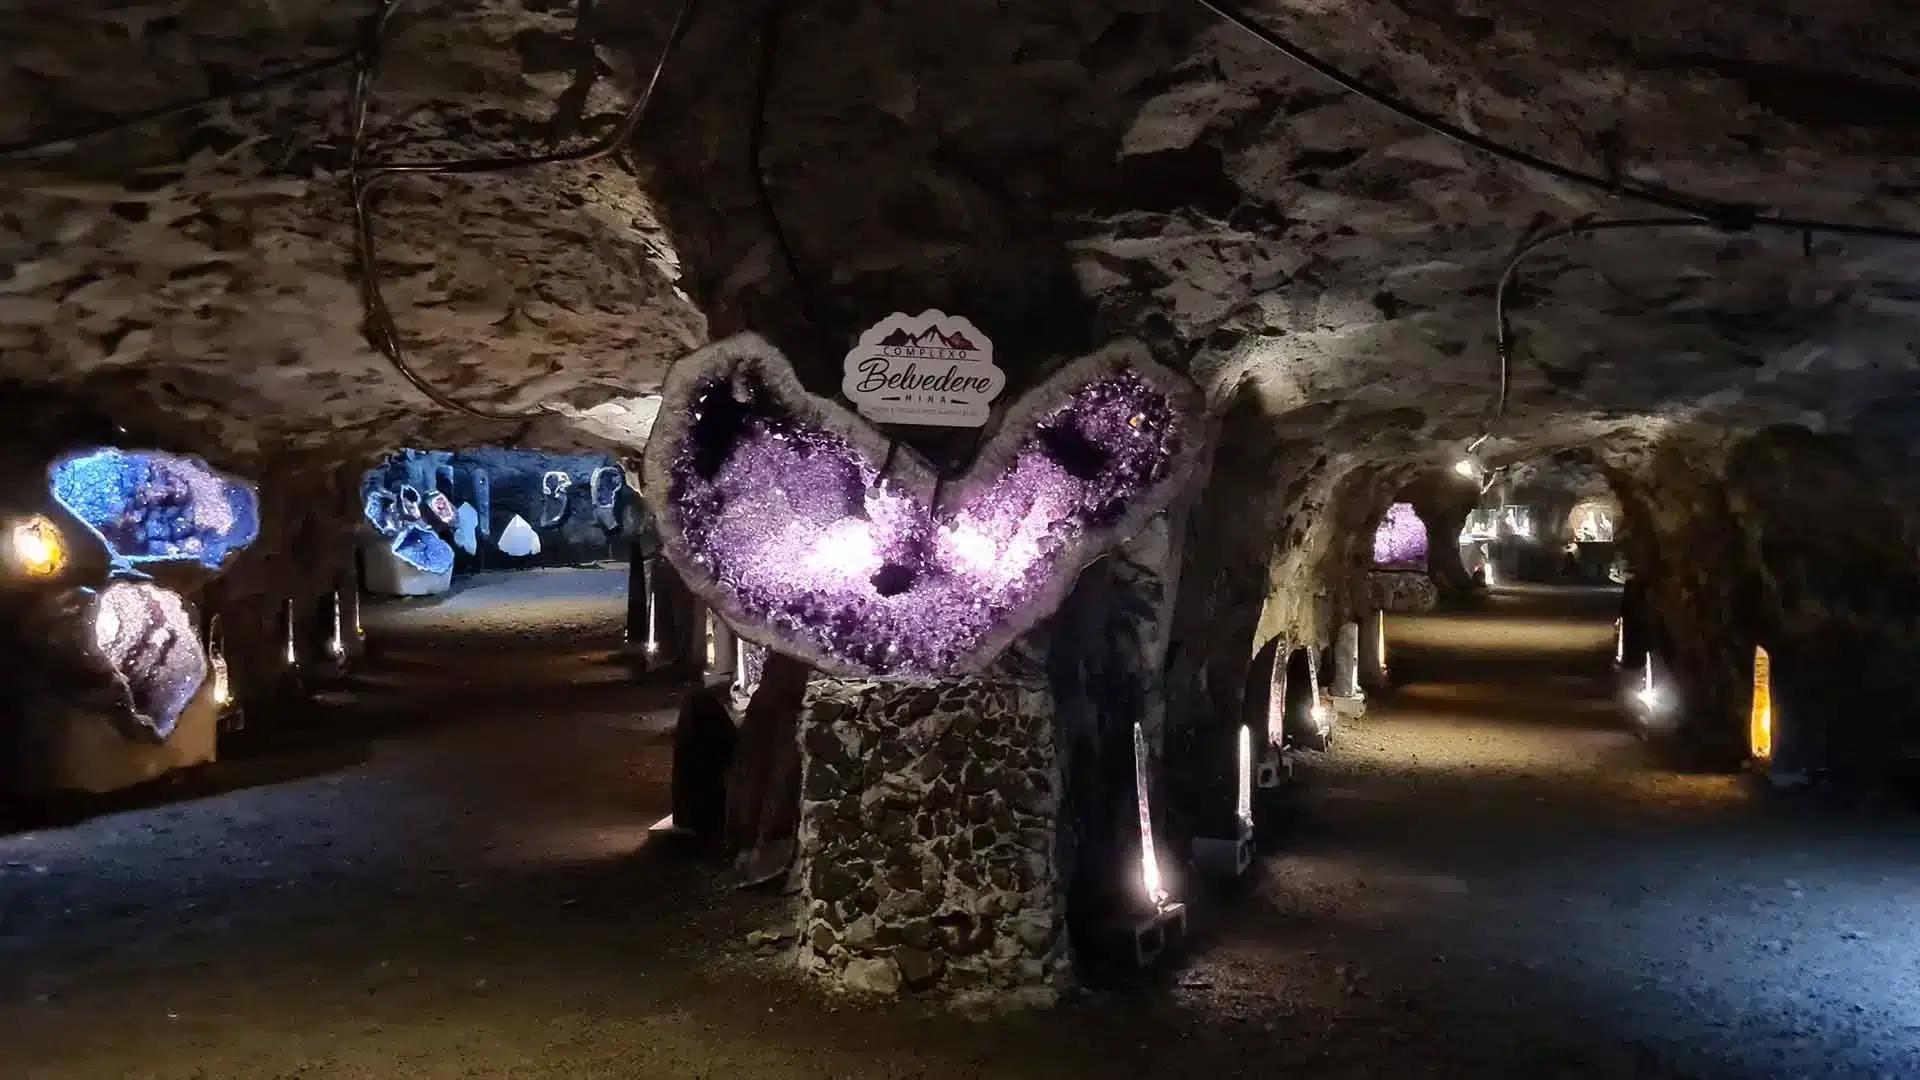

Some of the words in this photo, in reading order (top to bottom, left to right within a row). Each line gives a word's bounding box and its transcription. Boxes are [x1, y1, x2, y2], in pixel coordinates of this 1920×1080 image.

[883, 346, 967, 359] COMPLEXO
[856, 357, 992, 393] Belvedere
[905, 394, 946, 404] MINA
